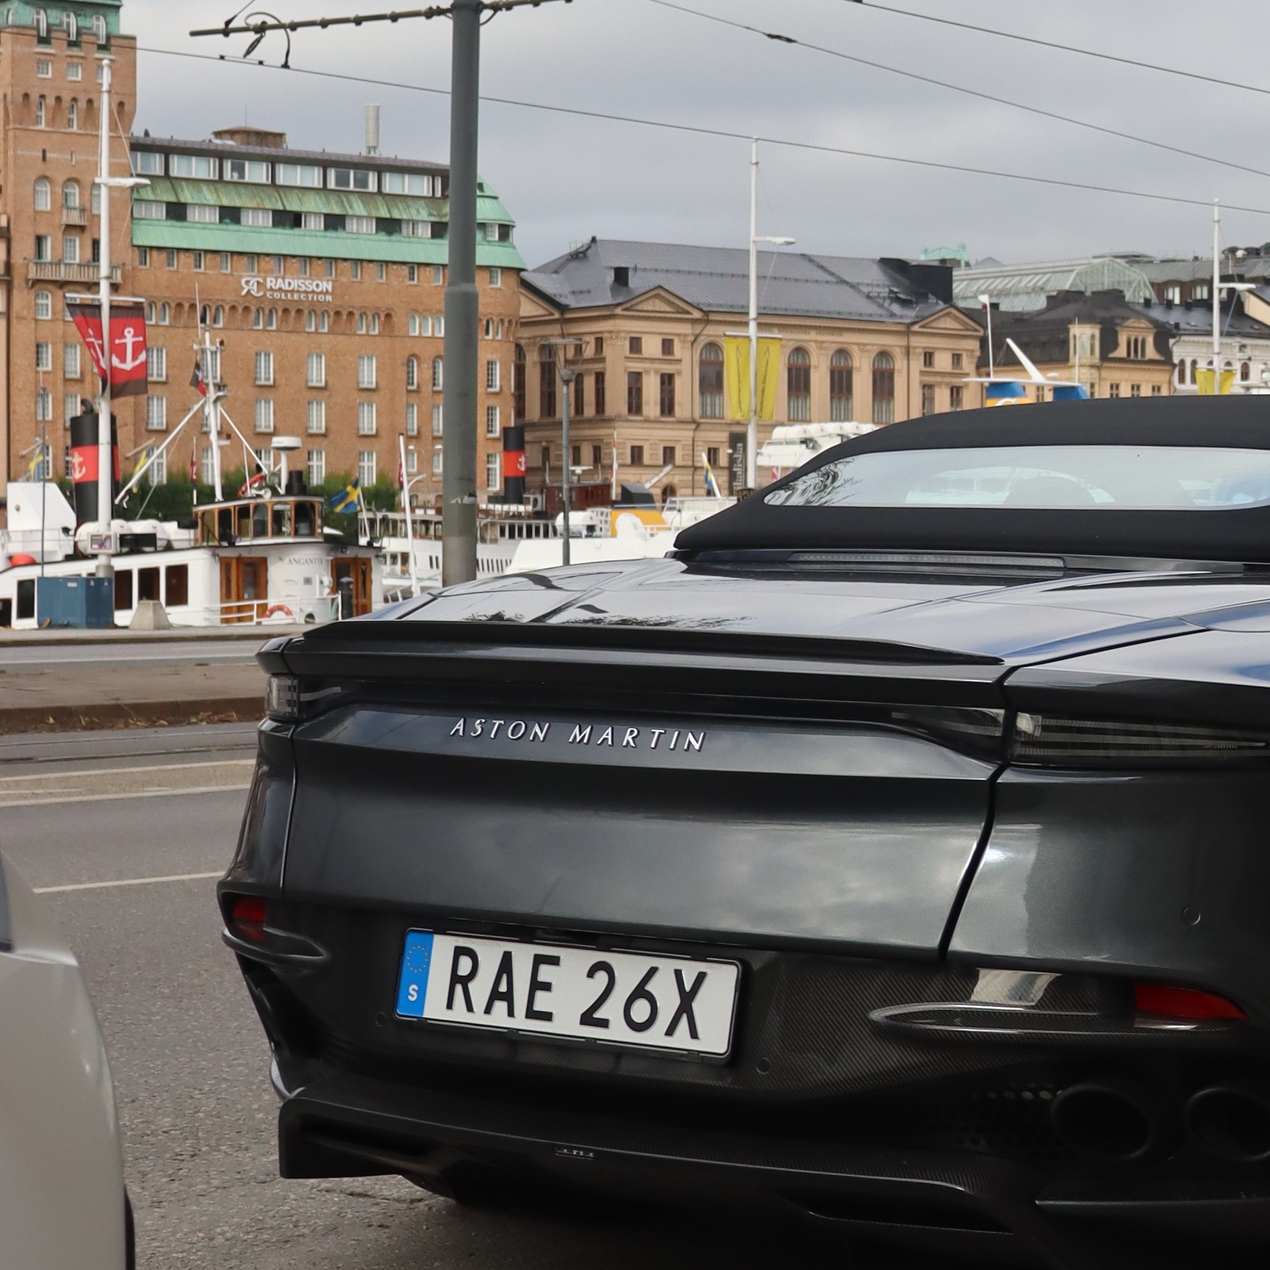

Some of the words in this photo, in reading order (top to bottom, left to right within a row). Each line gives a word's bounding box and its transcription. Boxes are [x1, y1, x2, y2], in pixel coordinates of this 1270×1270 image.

[266, 277, 333, 293] RADISSON
[266, 291, 333, 302] COLLECTION
[450, 717, 549, 743] ASTON
[568, 724, 706, 752] MARTIN
[408, 984, 419, 1002] S
[446, 945, 561, 1022] RAE
[579, 960, 708, 1040] 26X
